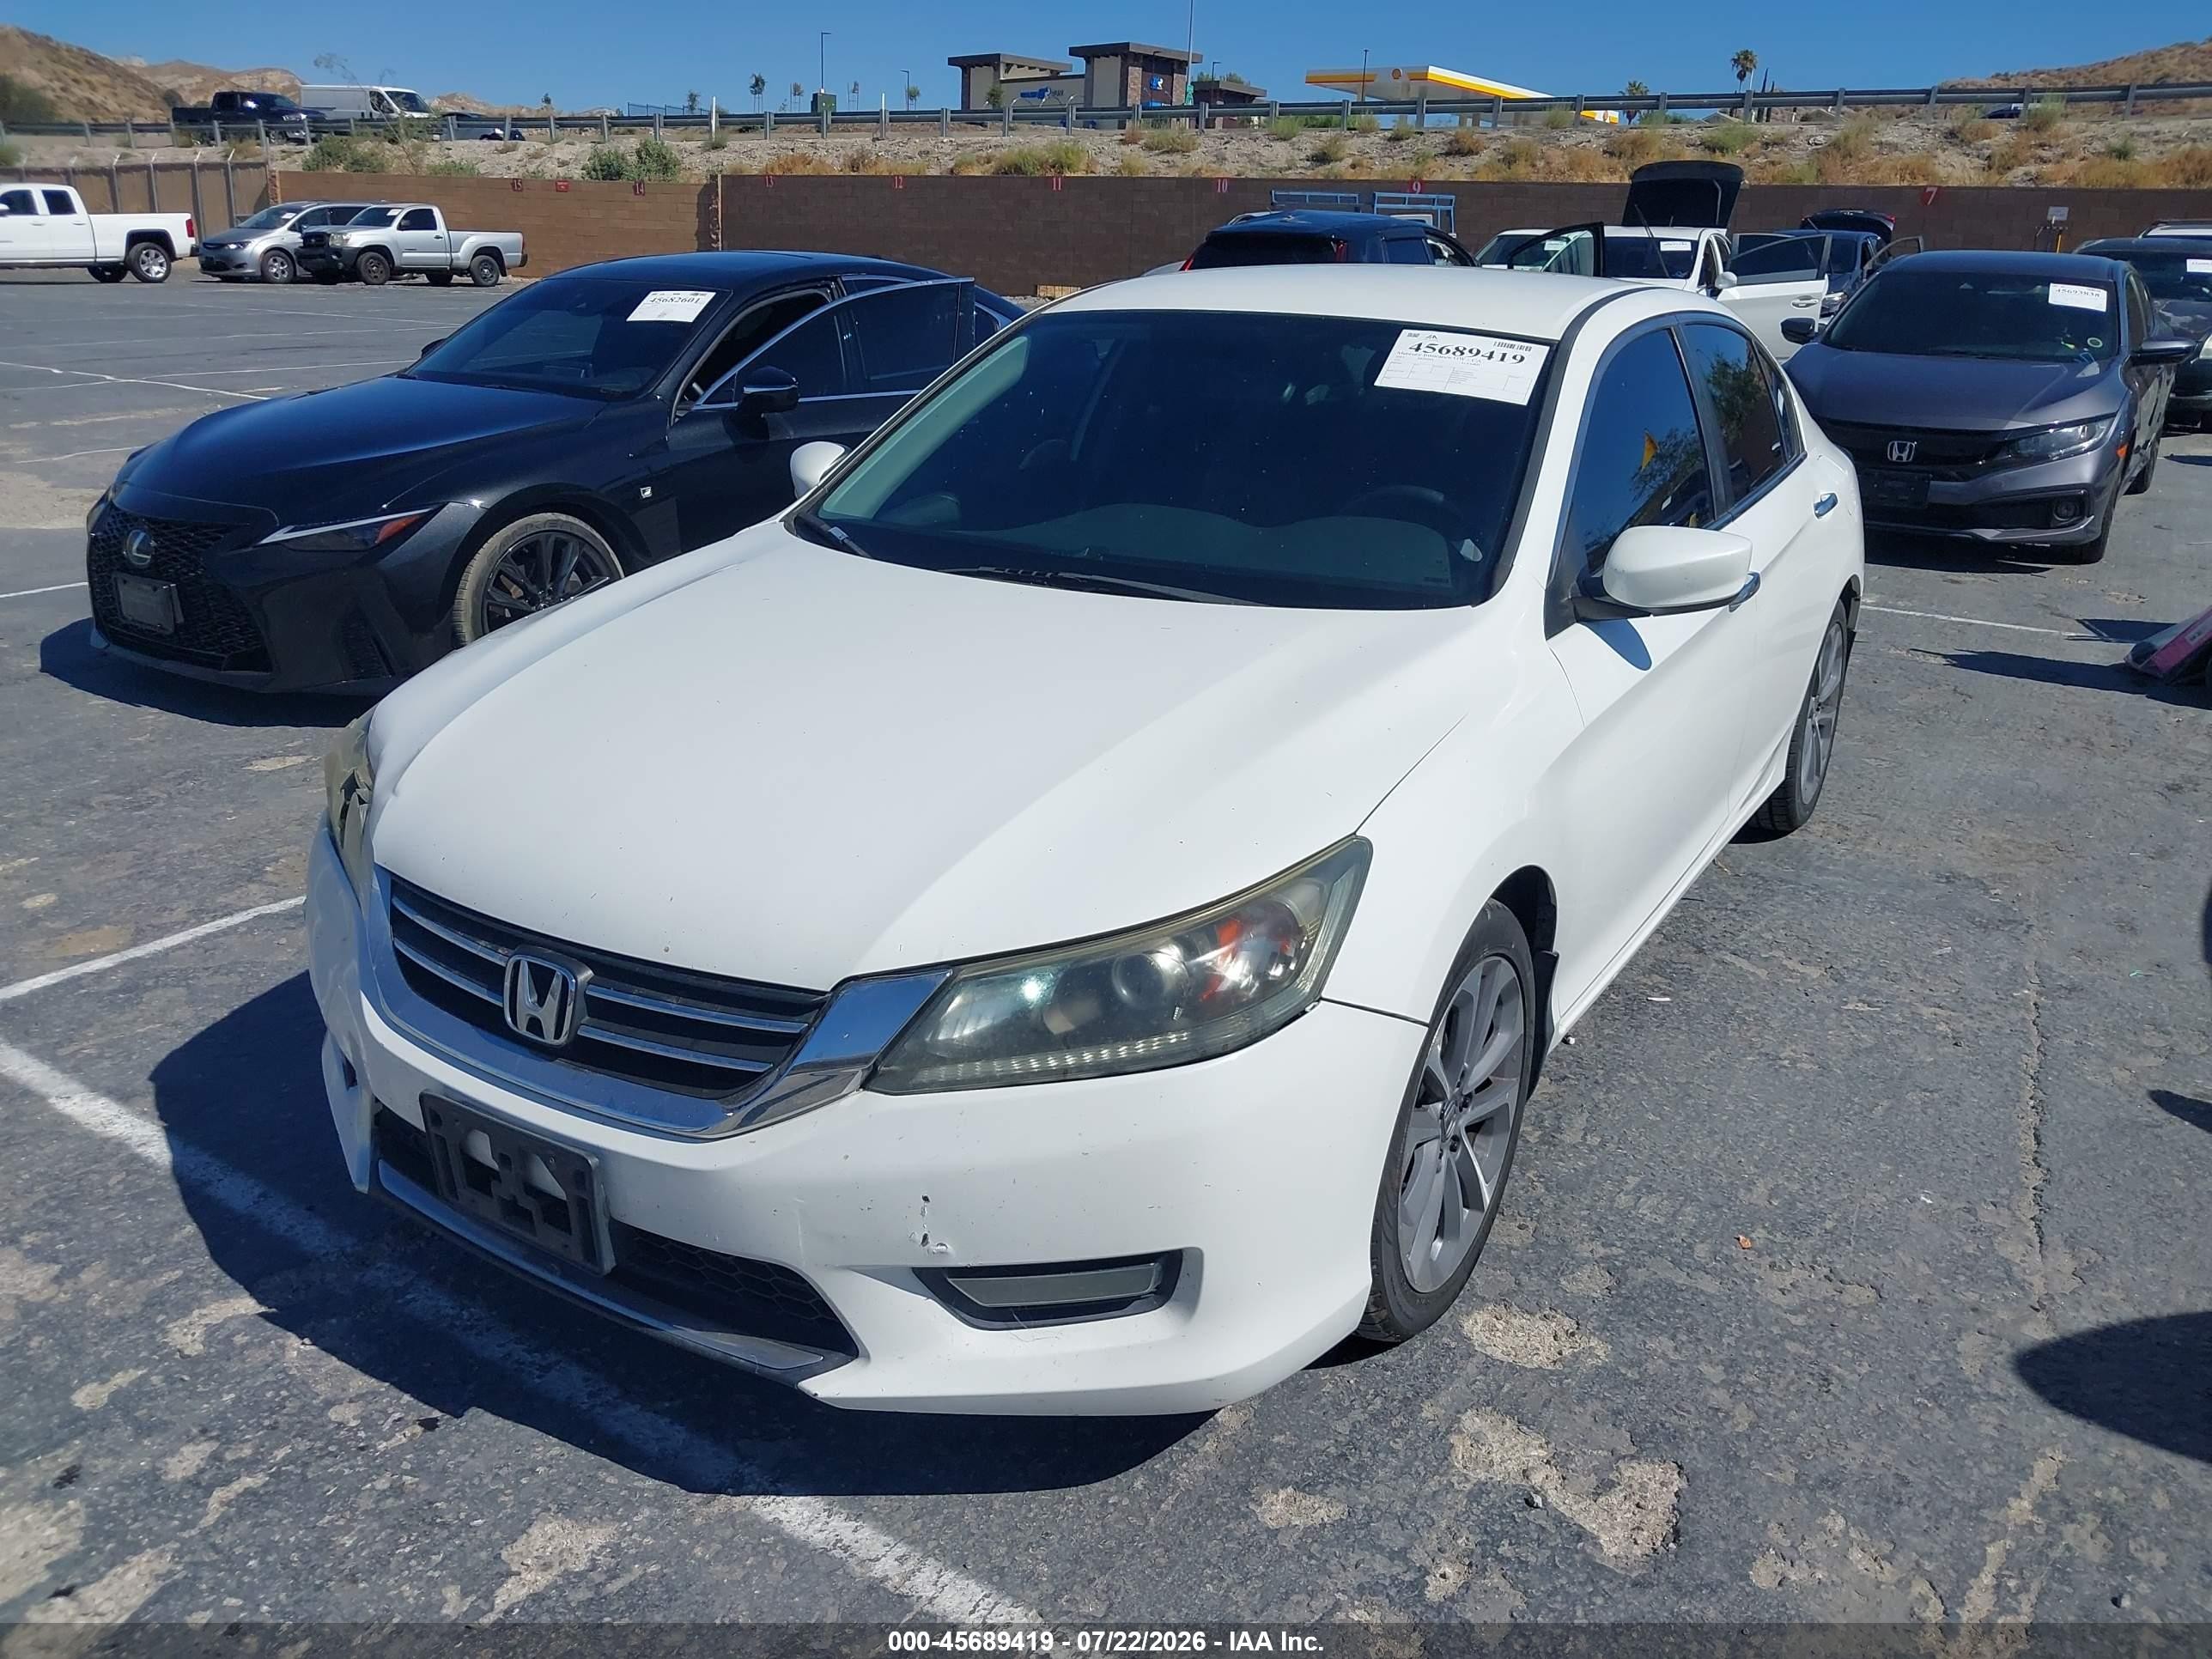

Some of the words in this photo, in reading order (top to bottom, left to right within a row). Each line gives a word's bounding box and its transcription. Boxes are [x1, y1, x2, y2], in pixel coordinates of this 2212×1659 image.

[514, 179, 522, 191] 15
[765, 175, 774, 188] 13
[895, 175, 902, 189] 12
[1053, 177, 1061, 191] 11
[1217, 178, 1228, 192] 10
[1412, 180, 1421, 194] 9
[1925, 186, 1938, 206] 7
[1408, 342, 1525, 365] 45689419
